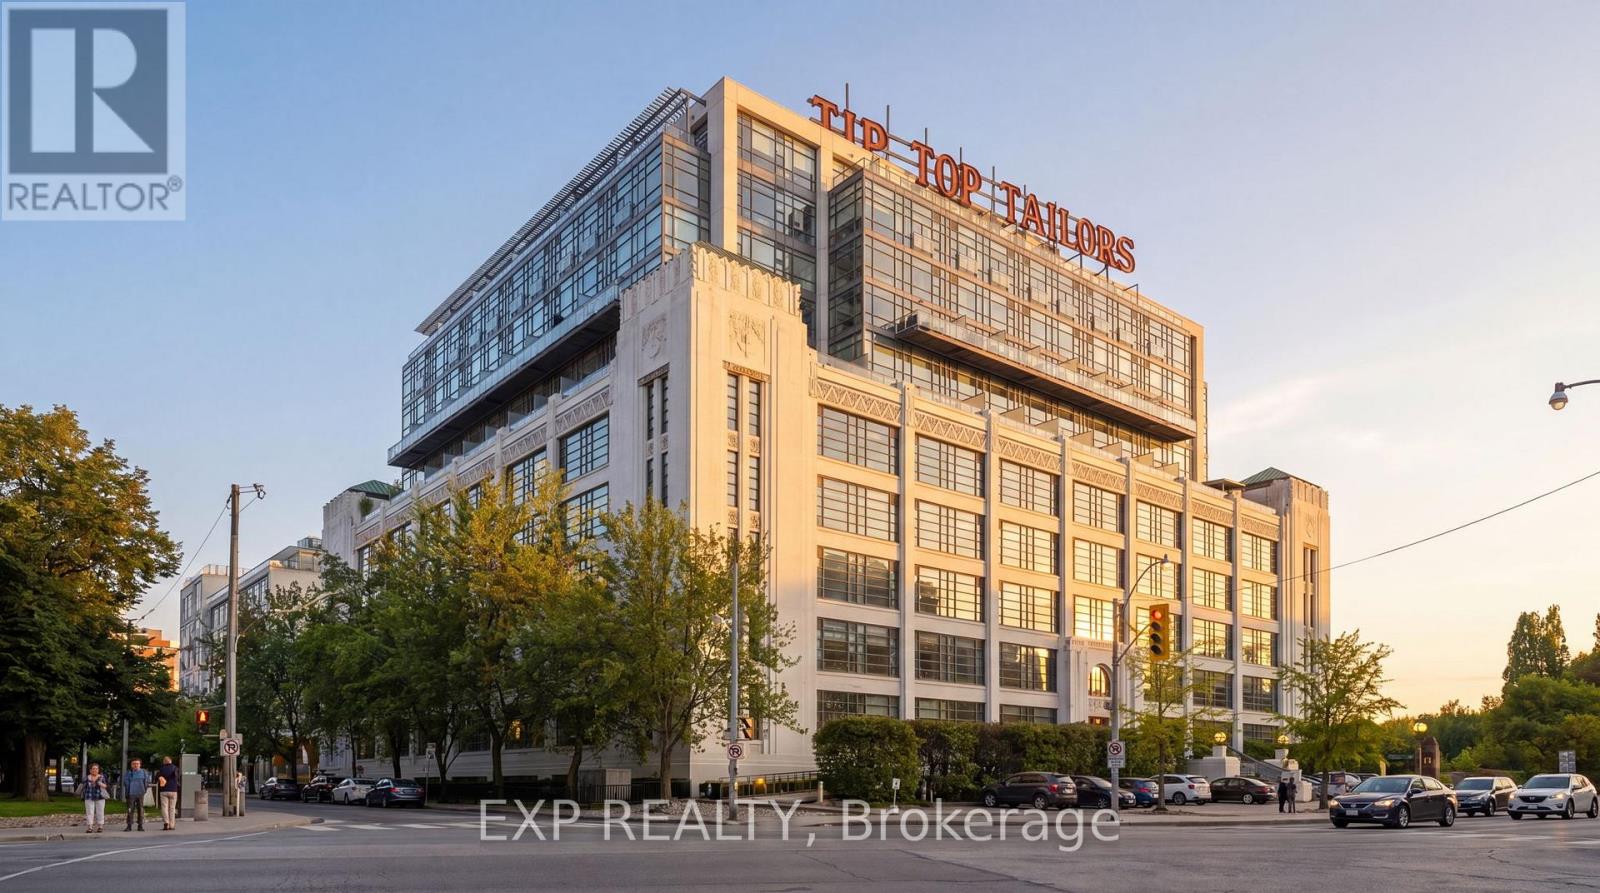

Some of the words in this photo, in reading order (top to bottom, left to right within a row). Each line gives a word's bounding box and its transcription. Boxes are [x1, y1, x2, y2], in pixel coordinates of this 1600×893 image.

[811, 94, 888, 152] TIP
[911, 140, 983, 208] TOP
[1001, 181, 1136, 274] TAILORS
